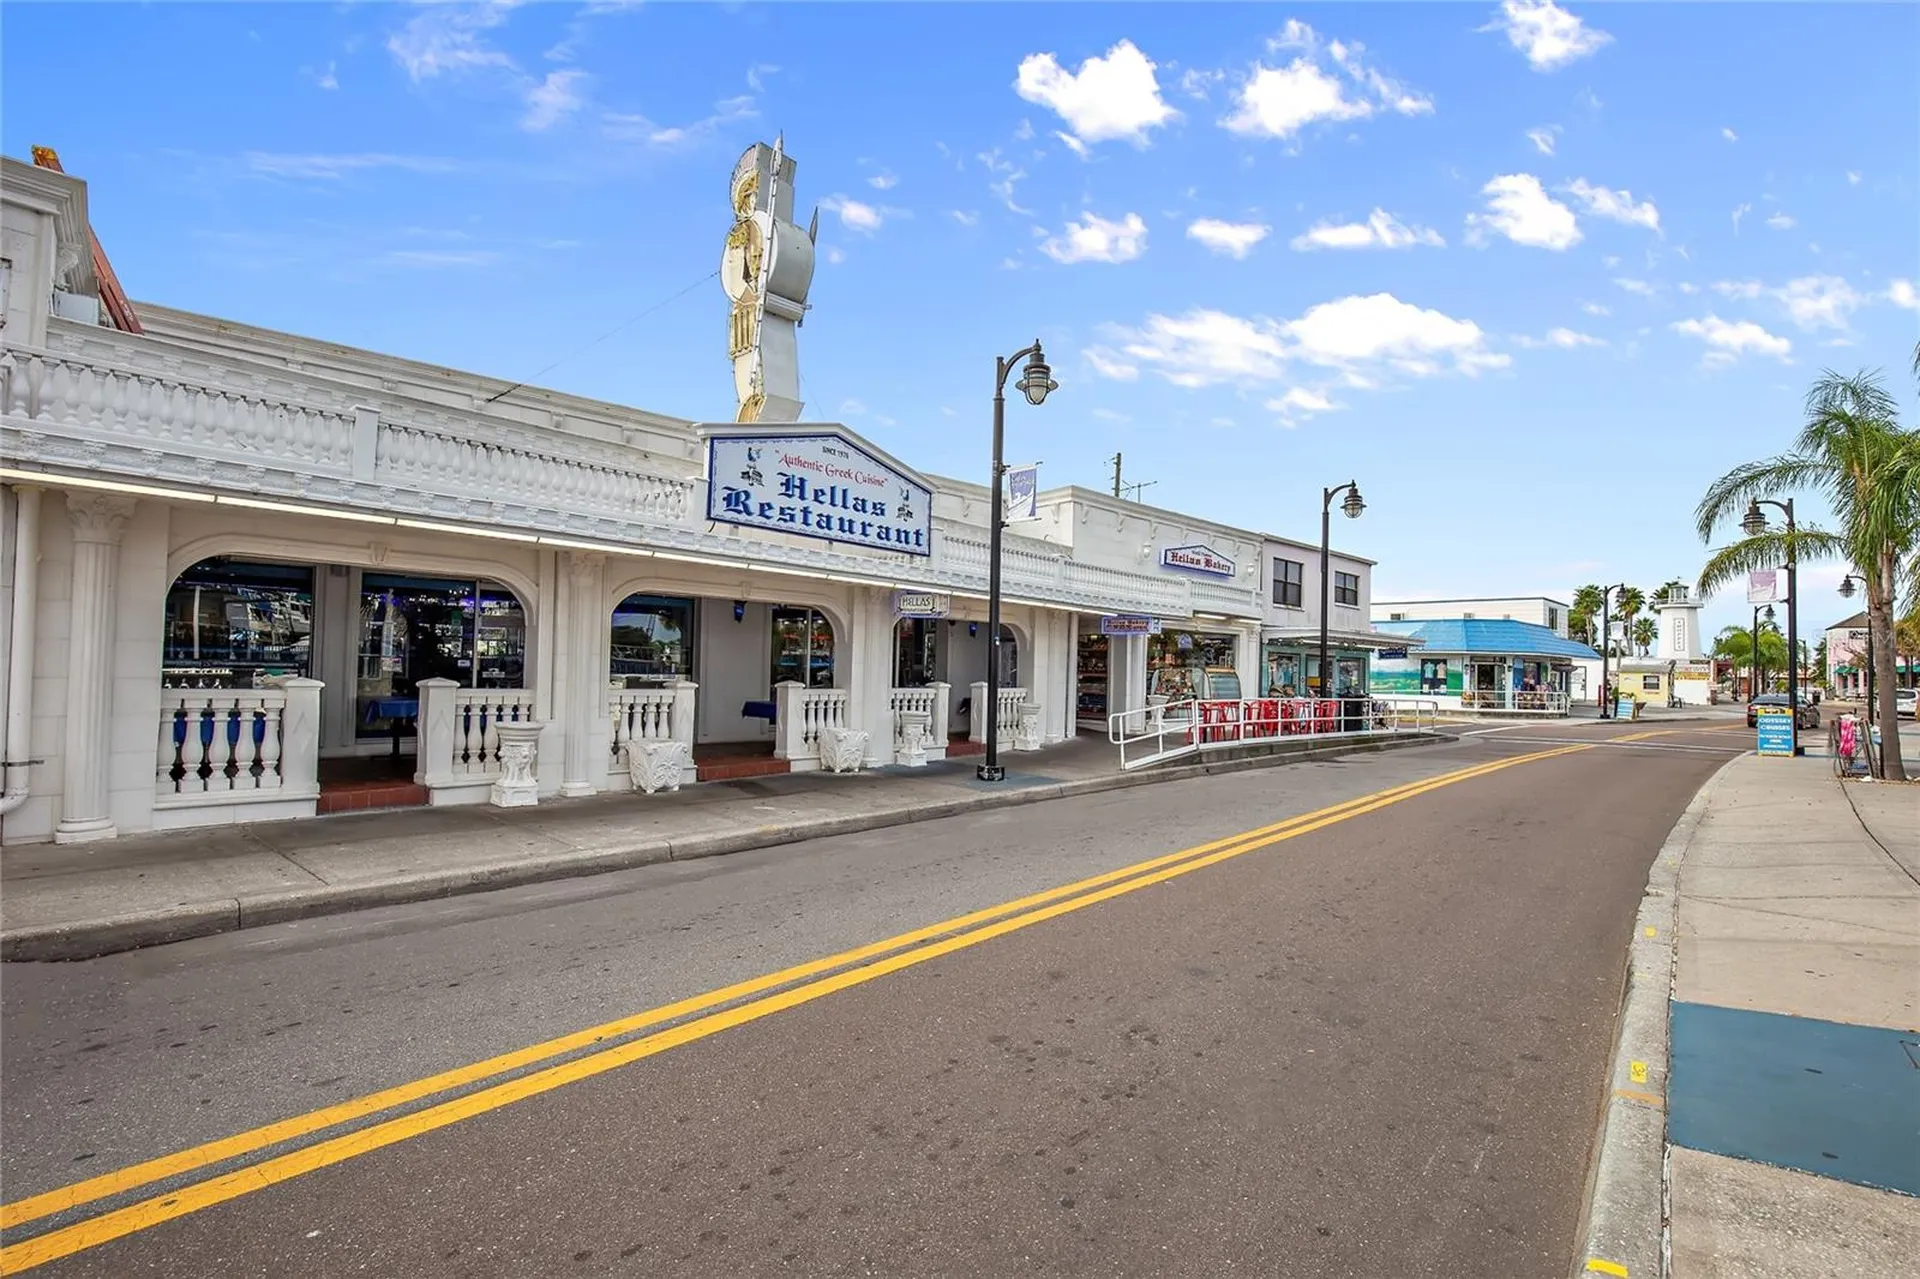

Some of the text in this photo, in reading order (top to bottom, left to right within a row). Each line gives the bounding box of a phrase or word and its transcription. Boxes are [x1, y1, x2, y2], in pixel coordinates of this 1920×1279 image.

[824, 462, 853, 480] Greek
[777, 472, 886, 517] Hellas
[722, 485, 923, 547] Restaurant
[1204, 557, 1231, 573] Bakery
[902, 596, 931, 607] HELLAS
